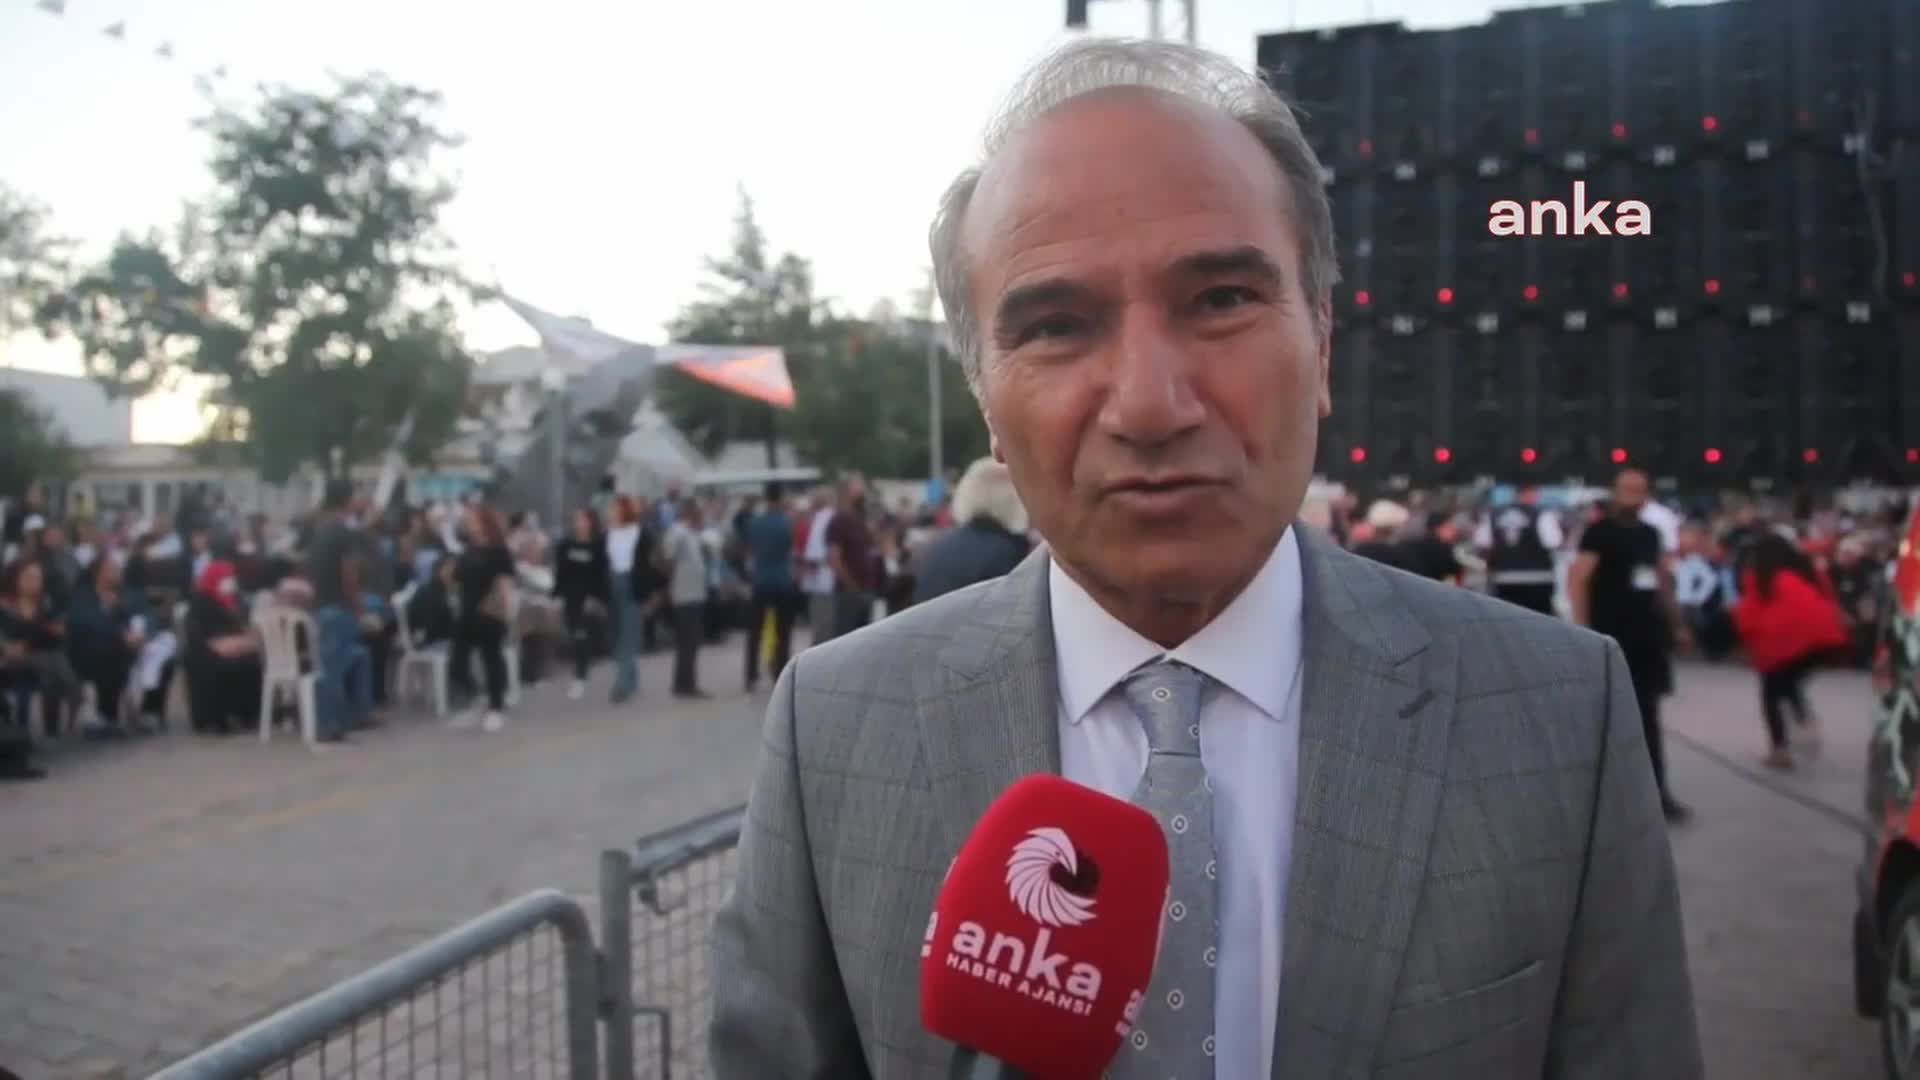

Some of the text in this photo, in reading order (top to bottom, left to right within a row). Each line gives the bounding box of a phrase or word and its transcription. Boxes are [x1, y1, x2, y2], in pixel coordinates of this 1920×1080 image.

[946, 953, 1012, 989] HABER
[1017, 980, 1092, 1016] AJANSI
[952, 921, 1102, 1000] anka
